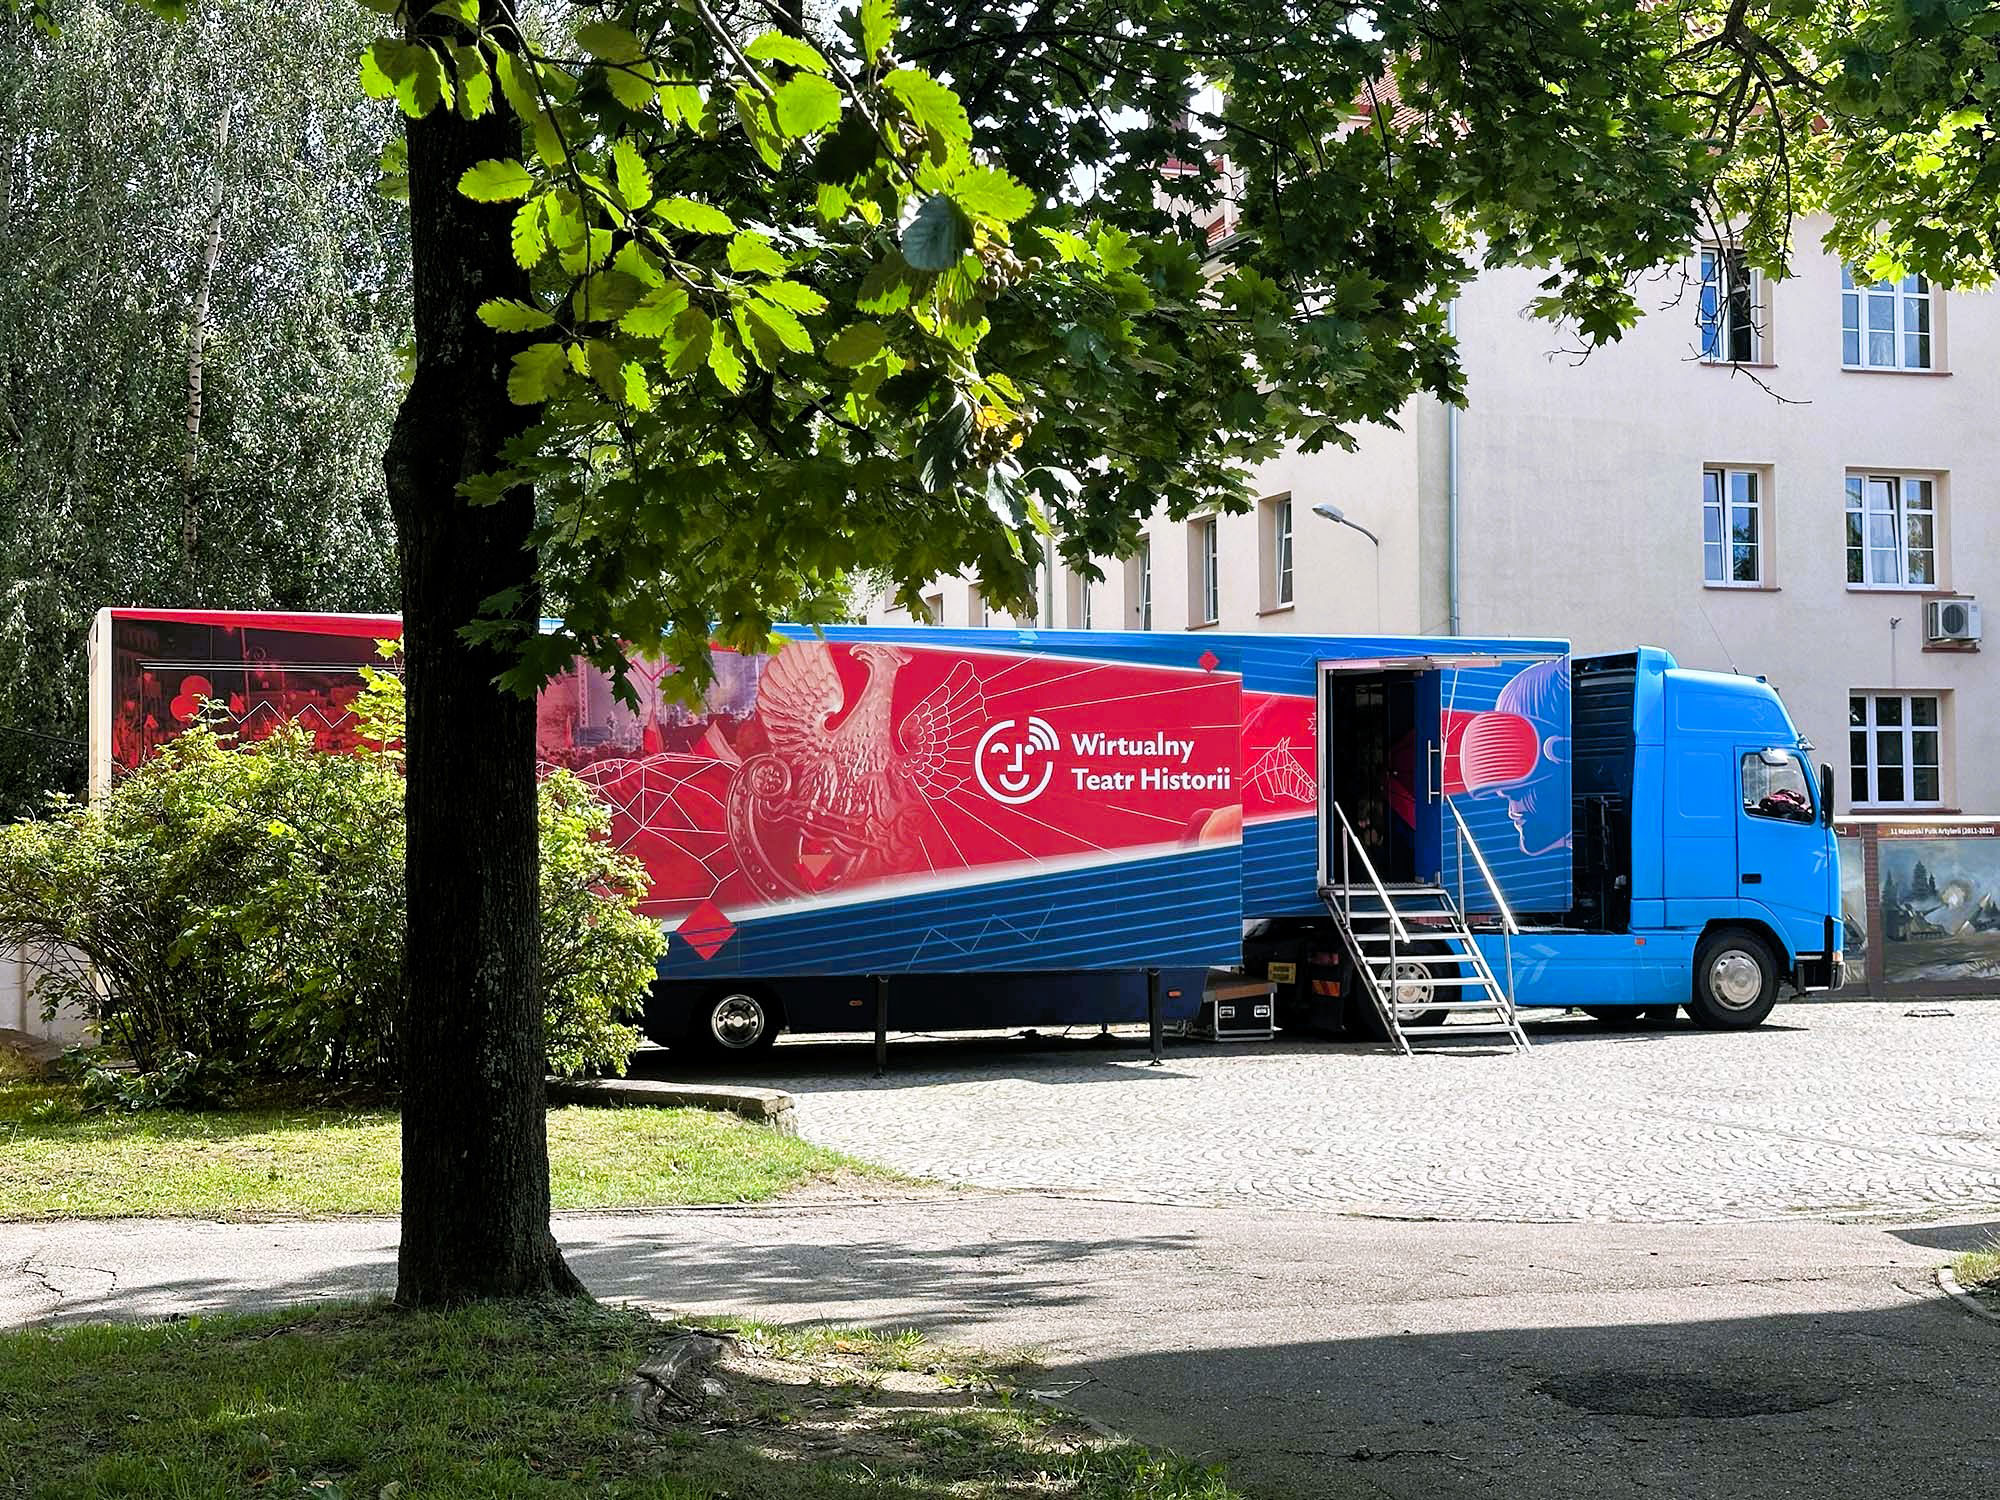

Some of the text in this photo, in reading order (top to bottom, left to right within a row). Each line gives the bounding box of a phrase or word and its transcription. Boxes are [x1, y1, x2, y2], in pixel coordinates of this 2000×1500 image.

[1071, 731, 1195, 764] Wirtualny
[1071, 767, 1231, 790] Teatr Historii
